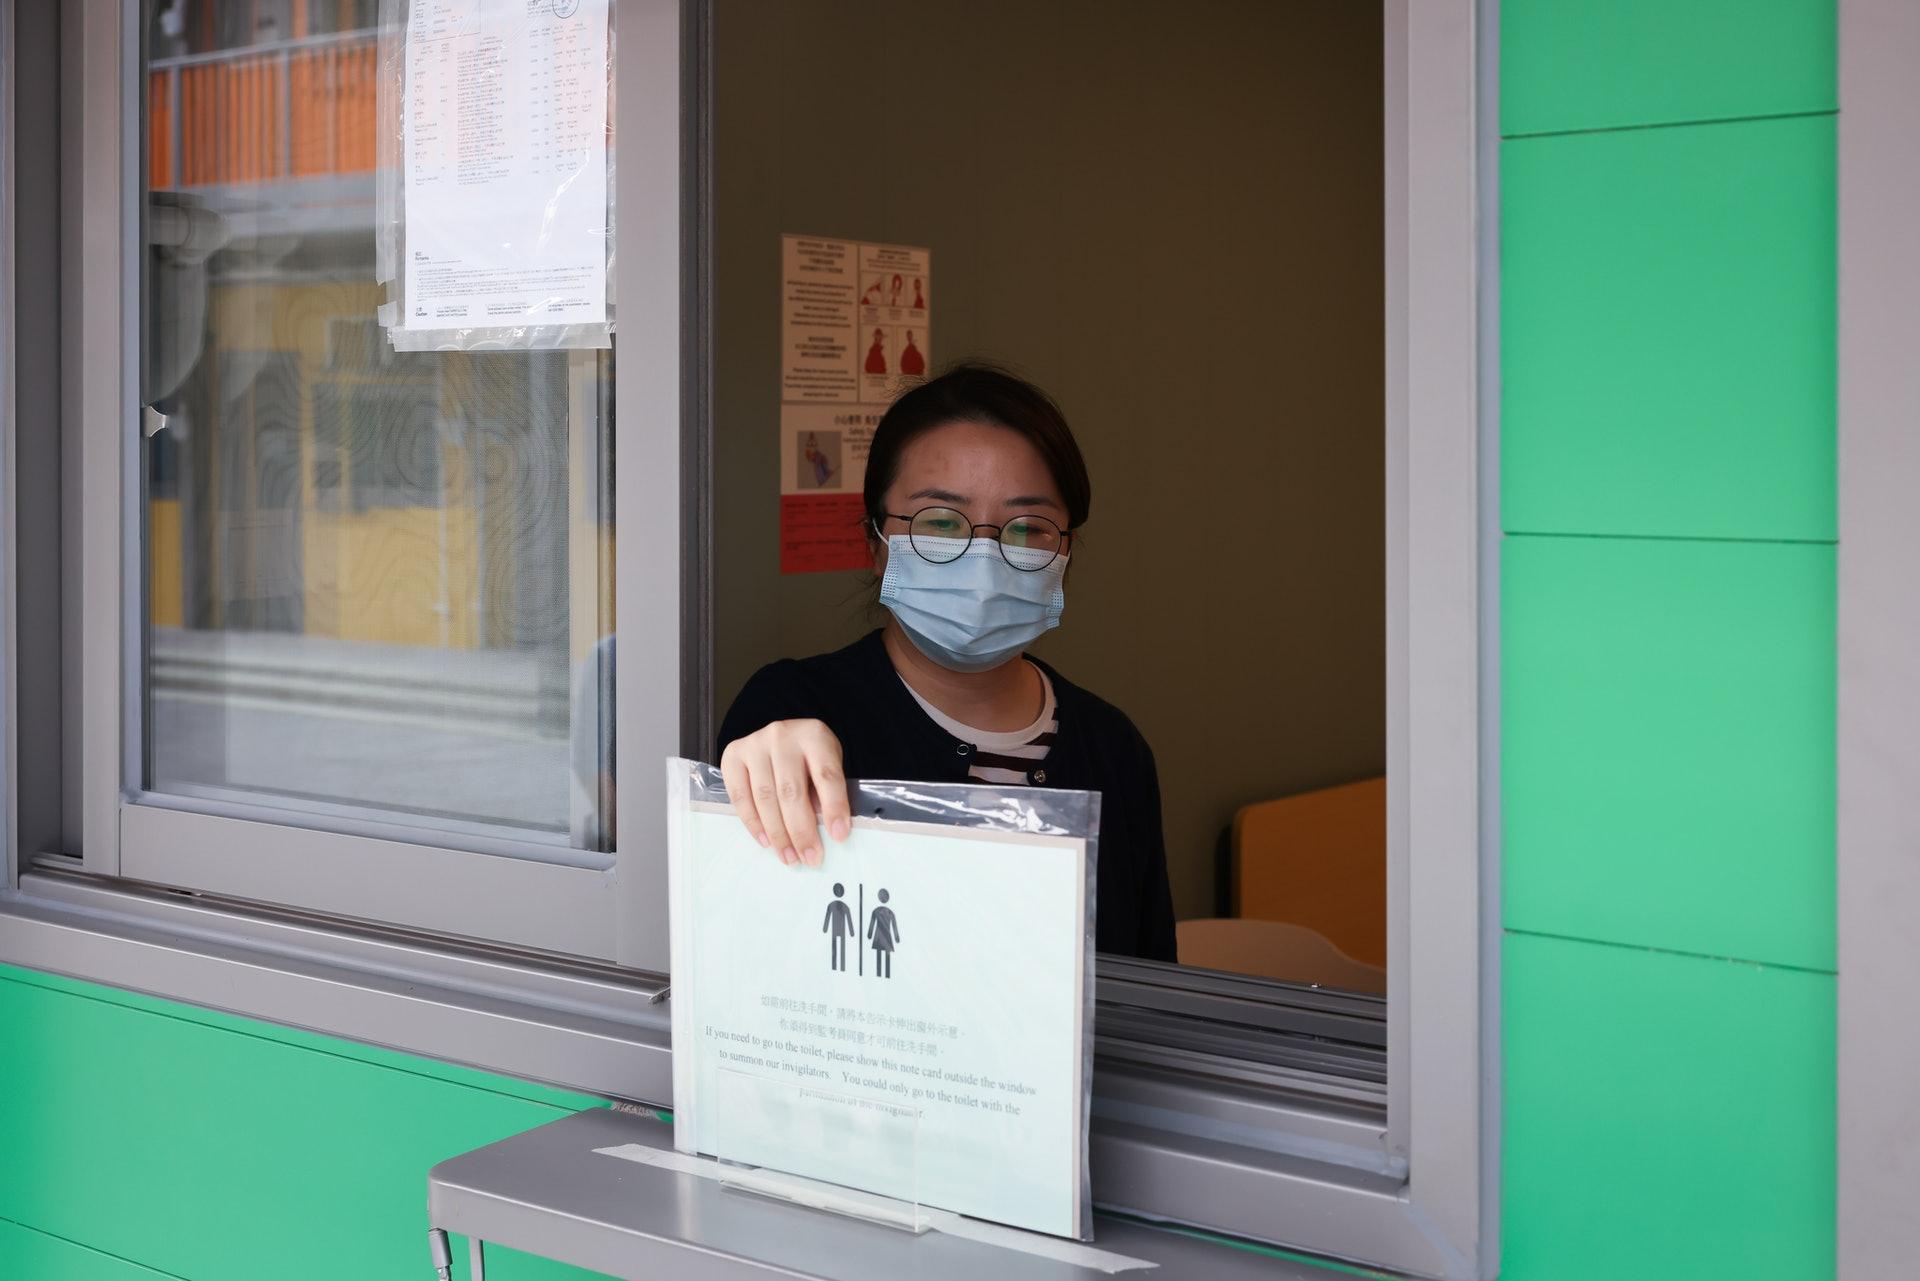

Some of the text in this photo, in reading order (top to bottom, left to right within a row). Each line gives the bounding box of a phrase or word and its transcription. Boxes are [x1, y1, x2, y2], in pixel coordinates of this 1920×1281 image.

[705, 1025, 1037, 1096] If you need to go to the toilet, please show this note card outside the window
[719, 1050, 1021, 1115] to summon our invigilators. You could only go to the toilet with the
